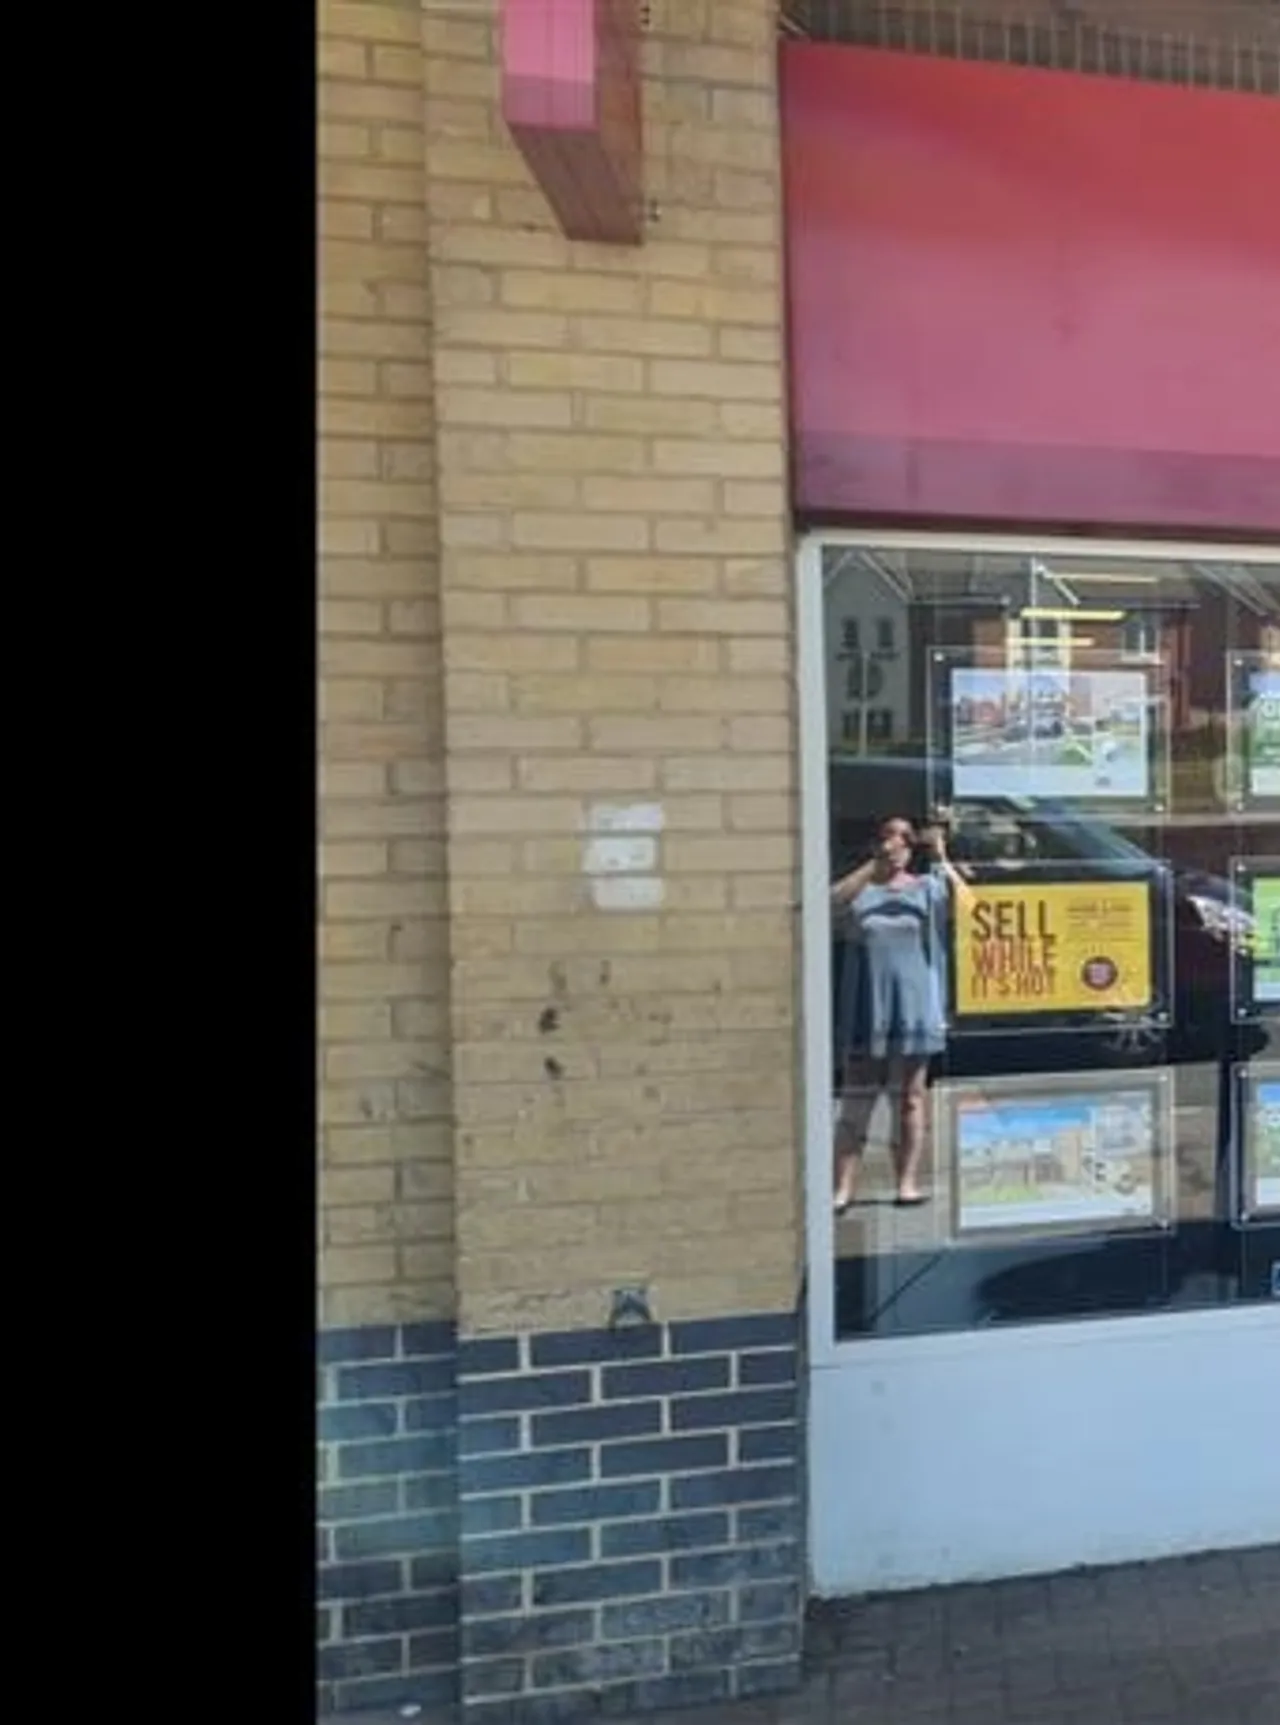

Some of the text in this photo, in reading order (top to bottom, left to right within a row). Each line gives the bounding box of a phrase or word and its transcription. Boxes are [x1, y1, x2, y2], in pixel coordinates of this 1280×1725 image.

[971, 899, 1056, 942] SELL
[970, 938, 1056, 977] WHILE
[1018, 972, 1056, 996] HOT
